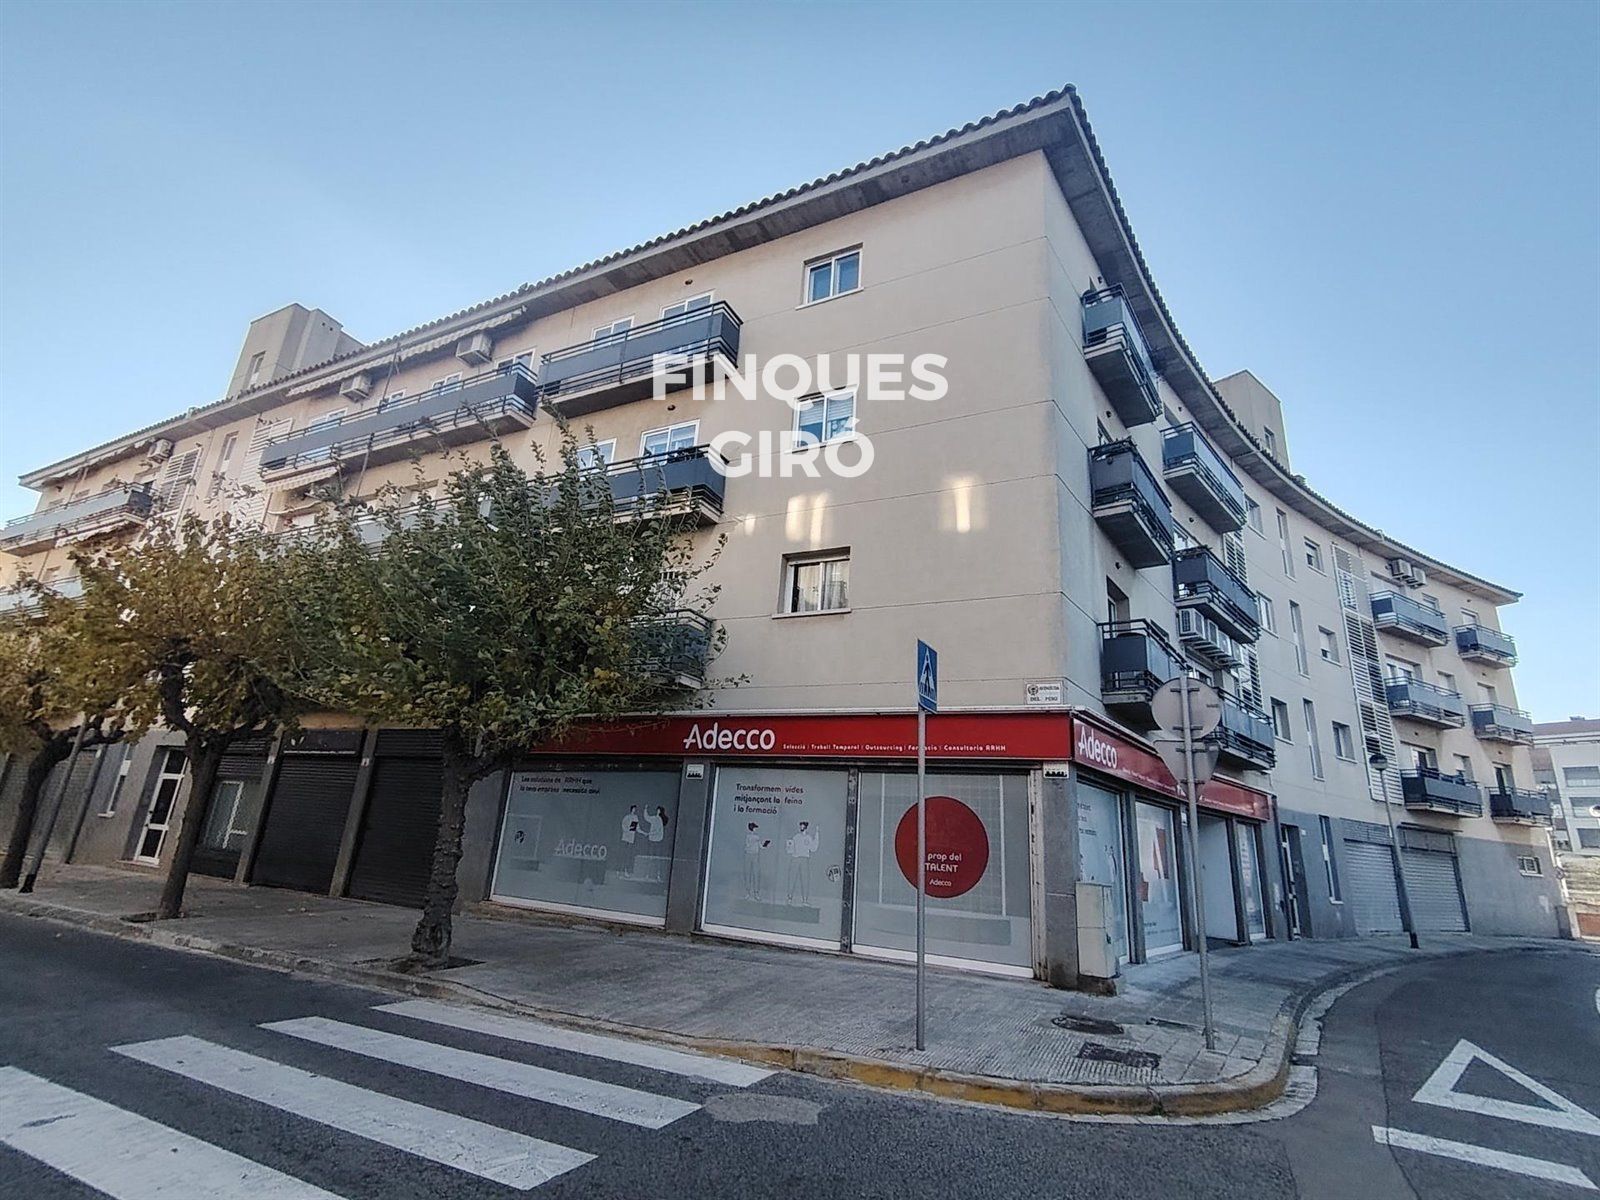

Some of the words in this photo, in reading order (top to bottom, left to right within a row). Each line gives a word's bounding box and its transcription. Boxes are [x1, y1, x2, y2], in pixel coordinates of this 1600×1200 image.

[683, 721, 776, 750] Adecco
[832, 743, 860, 752] Temporal
[865, 744, 903, 752] Outsourcing
[985, 744, 1006, 752] RRHH
[1078, 725, 1118, 769] Adecco
[736, 783, 781, 793] Transformem
[785, 785, 804, 794] vides
[734, 794, 772, 804] mitjançant
[784, 796, 803, 805] feina
[733, 804, 737, 812] i
[737, 805, 744, 813] la
[745, 805, 778, 815] formació
[553, 838, 608, 861] Adecco
[927, 852, 947, 862] prop
[949, 852, 962, 861] del
[925, 862, 959, 873] TALENT
[929, 878, 952, 887] Adecco
